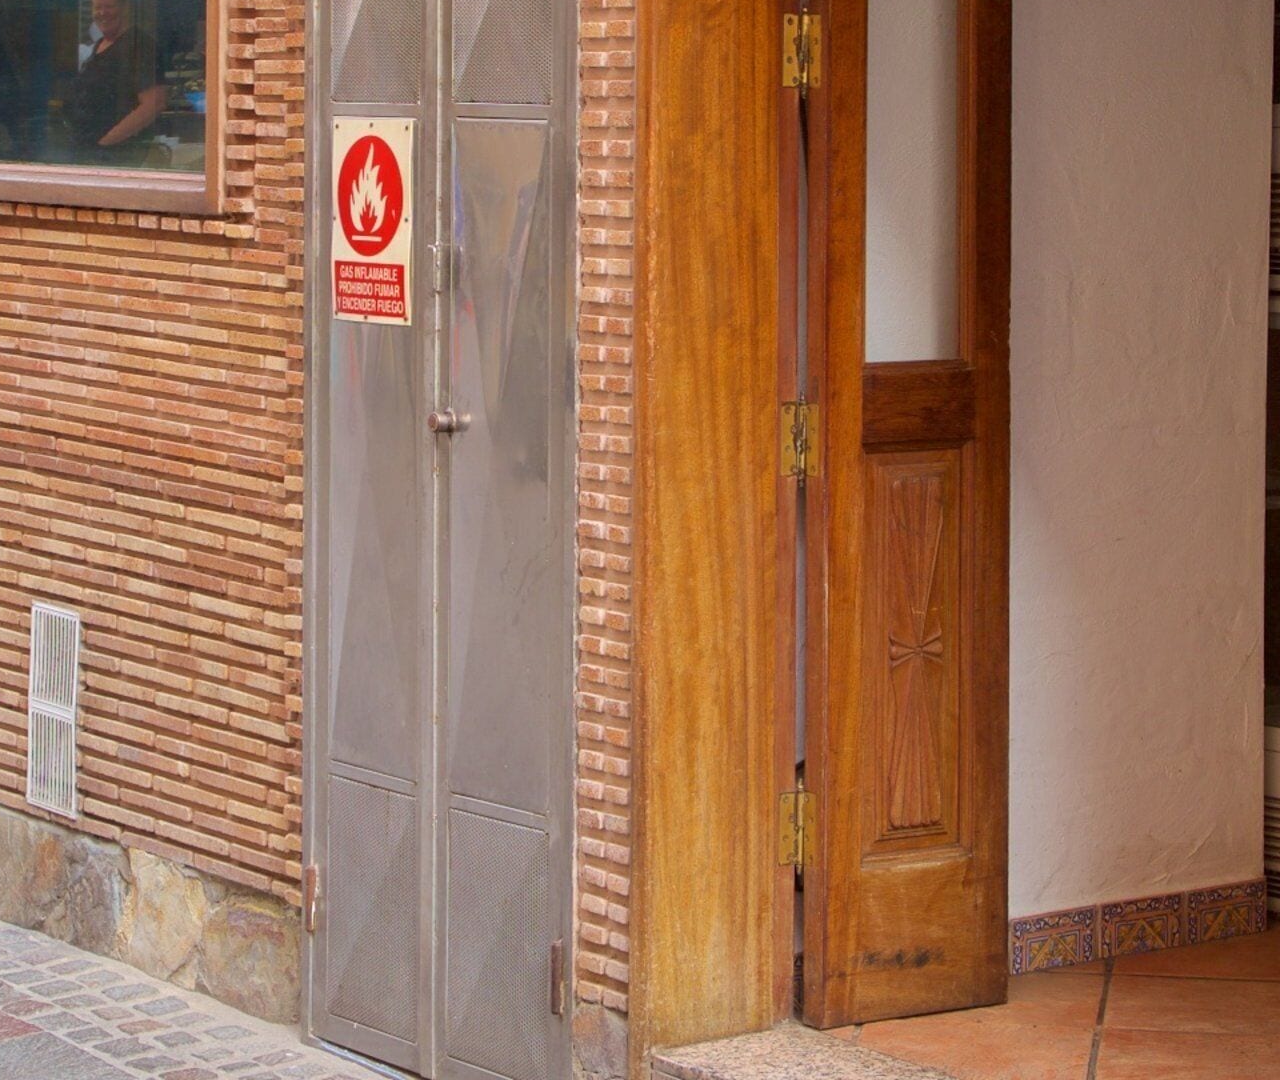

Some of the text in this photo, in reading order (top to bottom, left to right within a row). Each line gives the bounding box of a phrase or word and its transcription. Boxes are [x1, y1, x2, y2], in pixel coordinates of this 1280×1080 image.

[340, 265, 398, 282] GAS INFLAMABLE
[339, 281, 401, 298] PROHIBIDO FUMAR
[342, 296, 377, 312] ENCENDER
[377, 299, 404, 314] FUEGO
